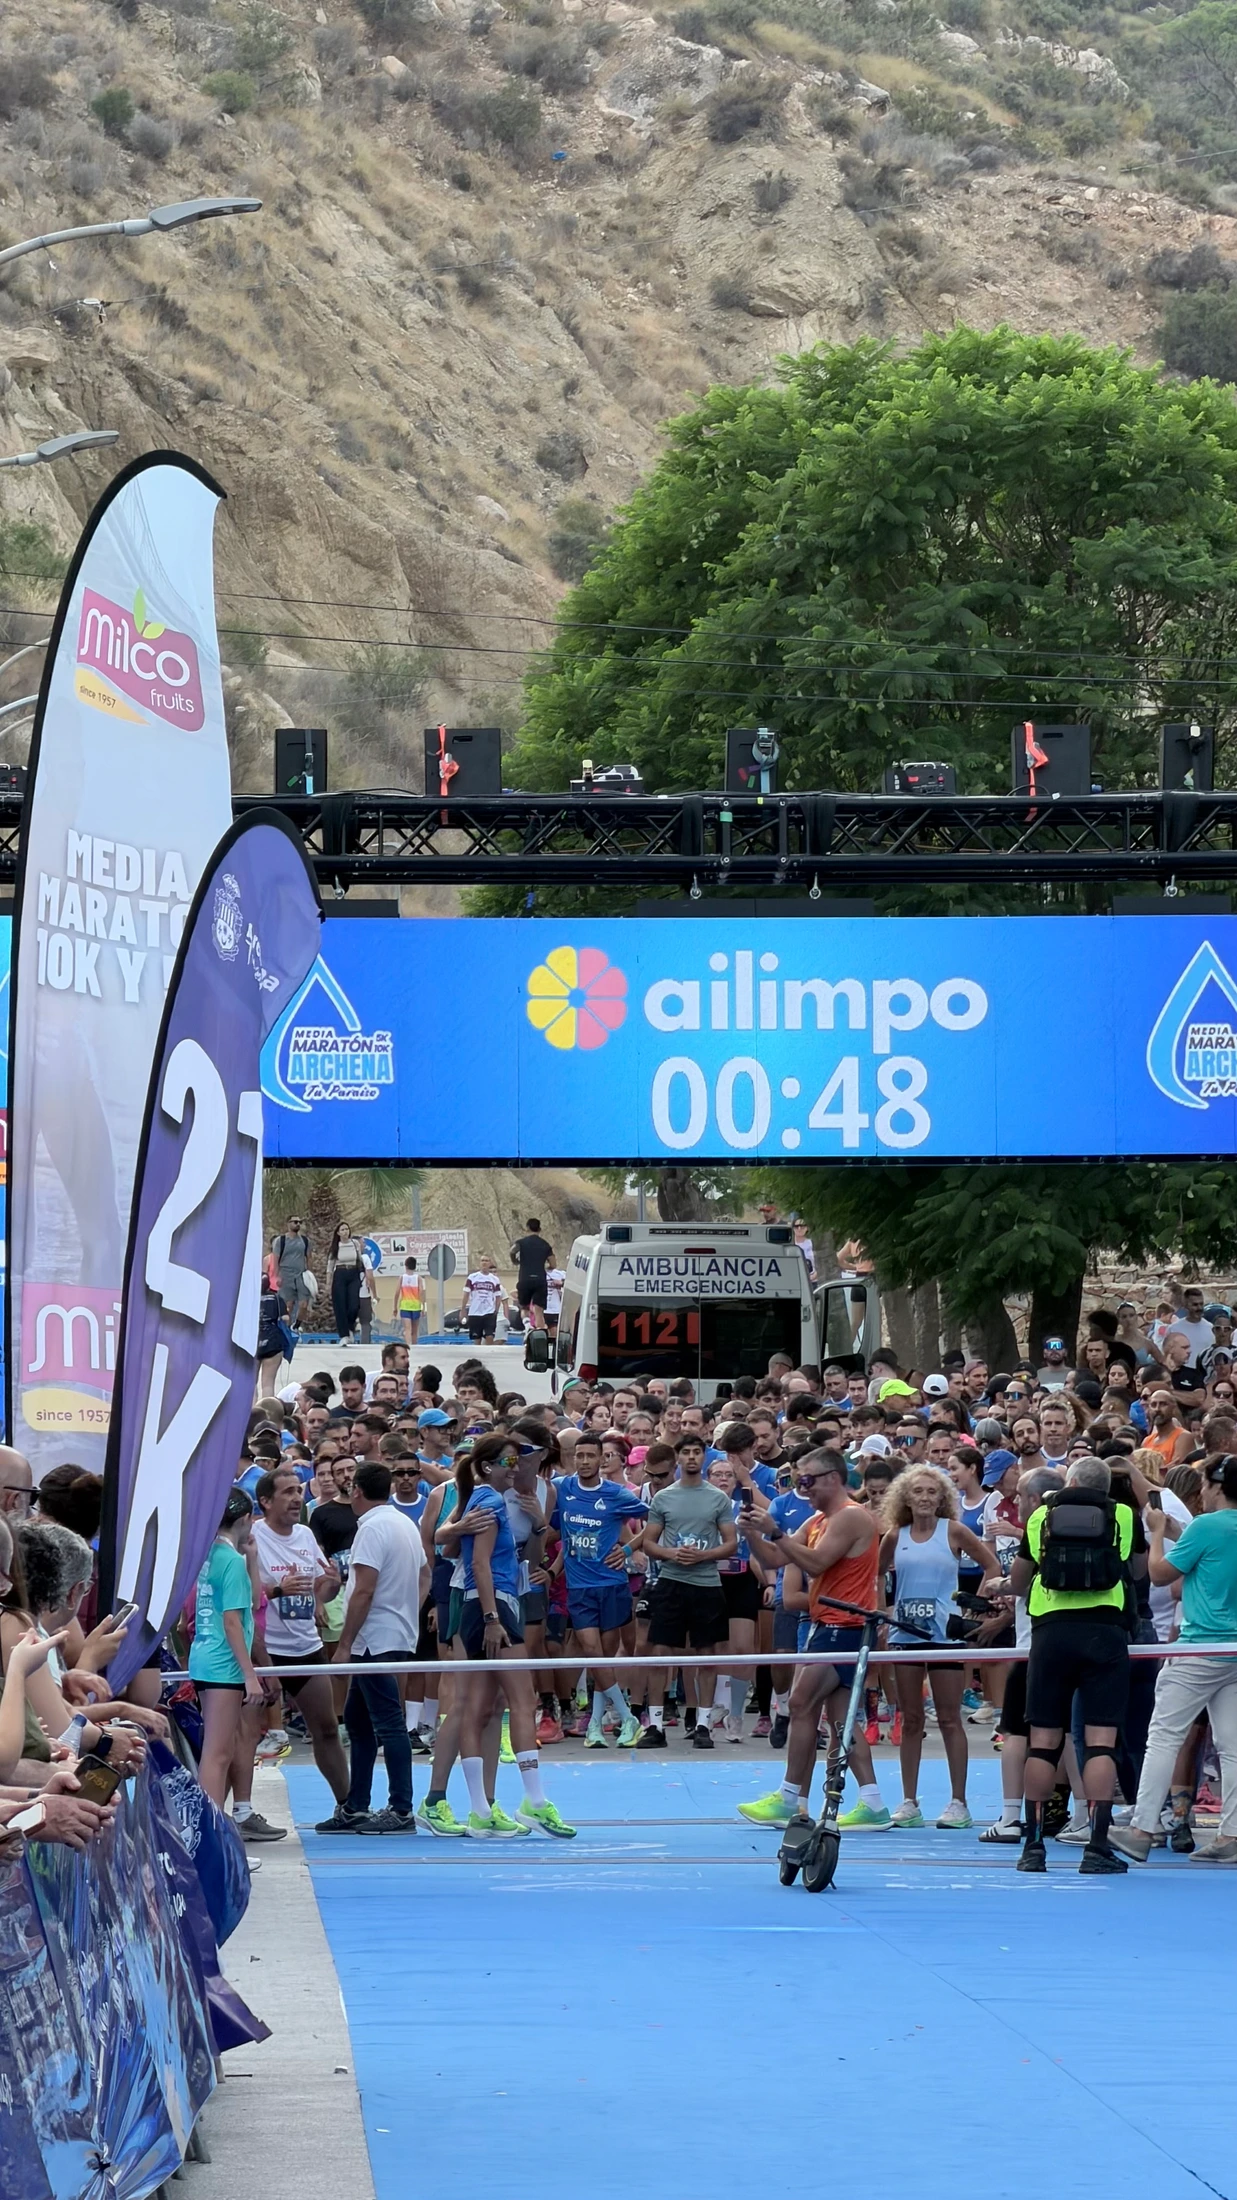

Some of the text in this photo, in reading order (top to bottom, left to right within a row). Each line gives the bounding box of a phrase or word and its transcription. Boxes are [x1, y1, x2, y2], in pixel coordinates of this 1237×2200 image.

[80, 685, 116, 708] since 1957
[150, 688, 195, 713] fruits
[67, 829, 190, 902] MEDIA
[37, 928, 103, 998] 10K
[116, 948, 148, 1003] Y
[644, 950, 988, 1054] ailimpo
[294, 1030, 334, 1038] MEDIA
[376, 1033, 389, 1042] 5K
[1190, 1027, 1229, 1035] MEDIA
[292, 1035, 374, 1053] MARATÓN
[1188, 1036, 1237, 1050] MARA
[290, 1053, 391, 1081] ARCHENA
[306, 1085, 322, 1097] Tu
[1203, 1081, 1218, 1094] Tu
[652, 1056, 931, 1149] 00:48
[618, 1257, 782, 1277] AMBULANCIA
[634, 1279, 766, 1294] EMERGENCIAS
[36, 1408, 73, 1421] since
[117, 1342, 231, 1631] K
[570, 1513, 602, 1528] ailimpo
[904, 1603, 934, 1617] 1465
